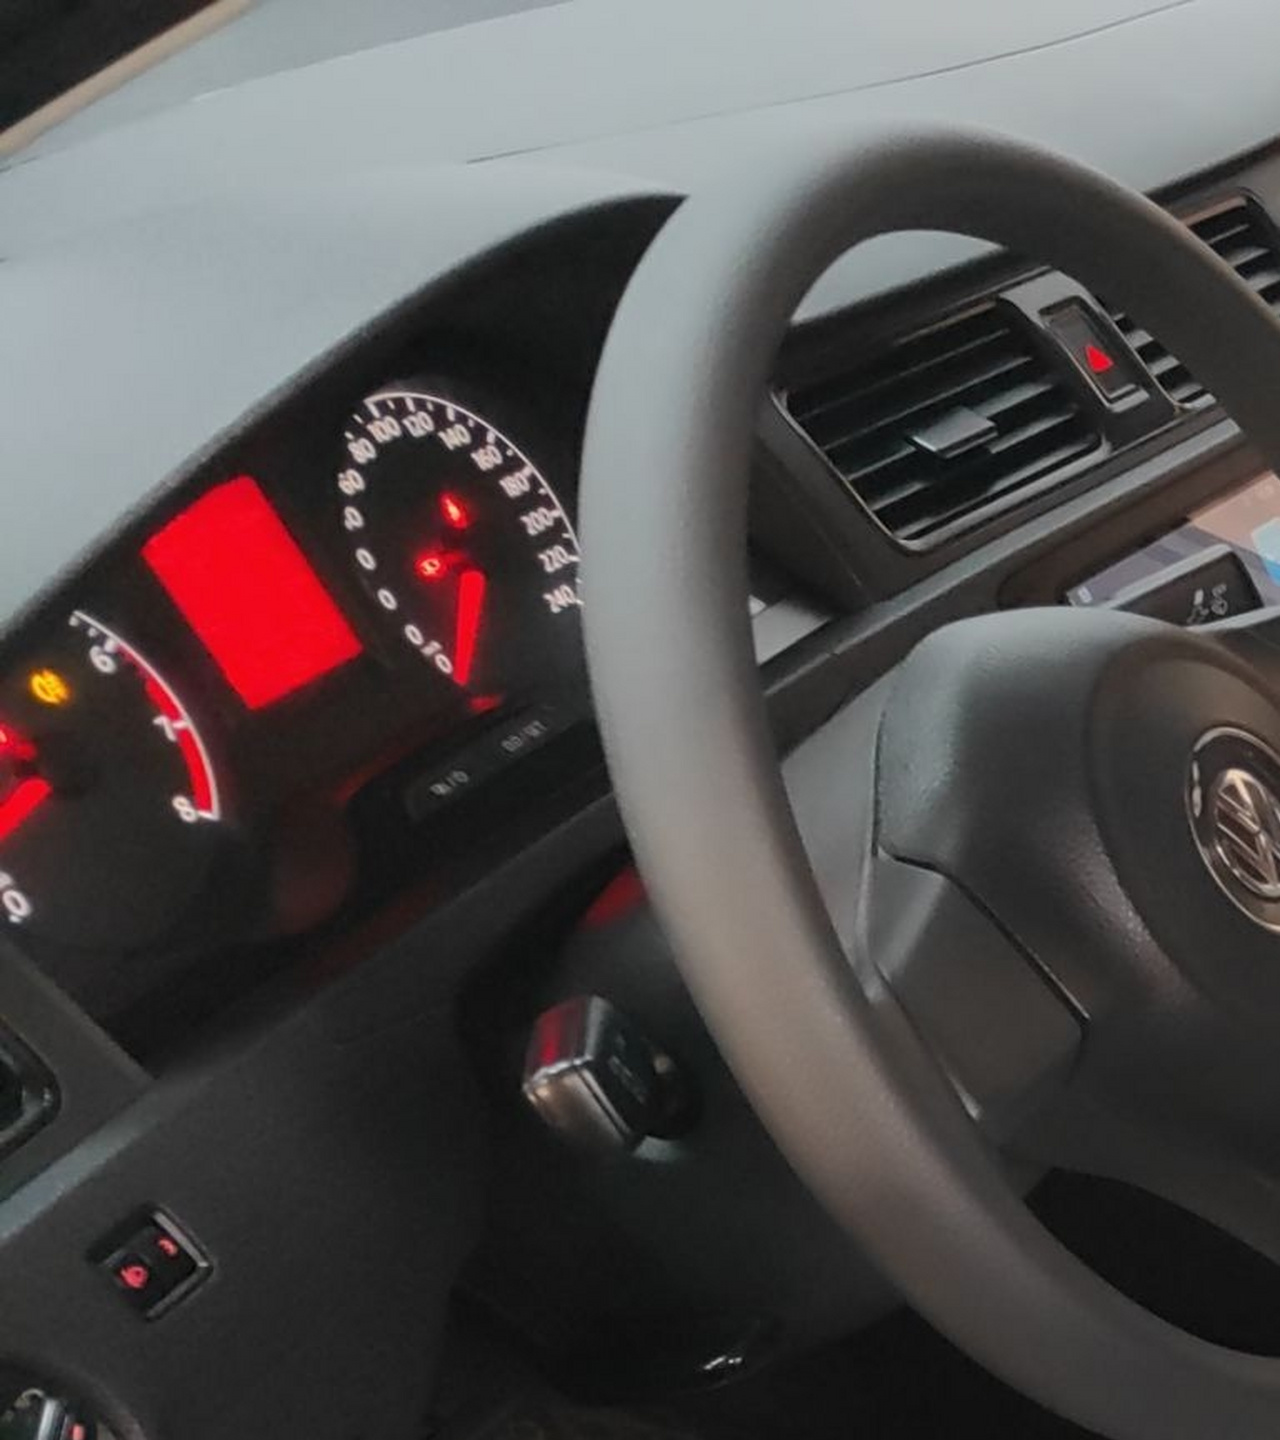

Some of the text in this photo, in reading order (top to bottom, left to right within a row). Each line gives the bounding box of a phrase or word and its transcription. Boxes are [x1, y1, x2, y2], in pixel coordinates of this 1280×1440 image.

[89, 645, 117, 675] 6
[153, 715, 178, 742] 7
[172, 796, 199, 823] 8
